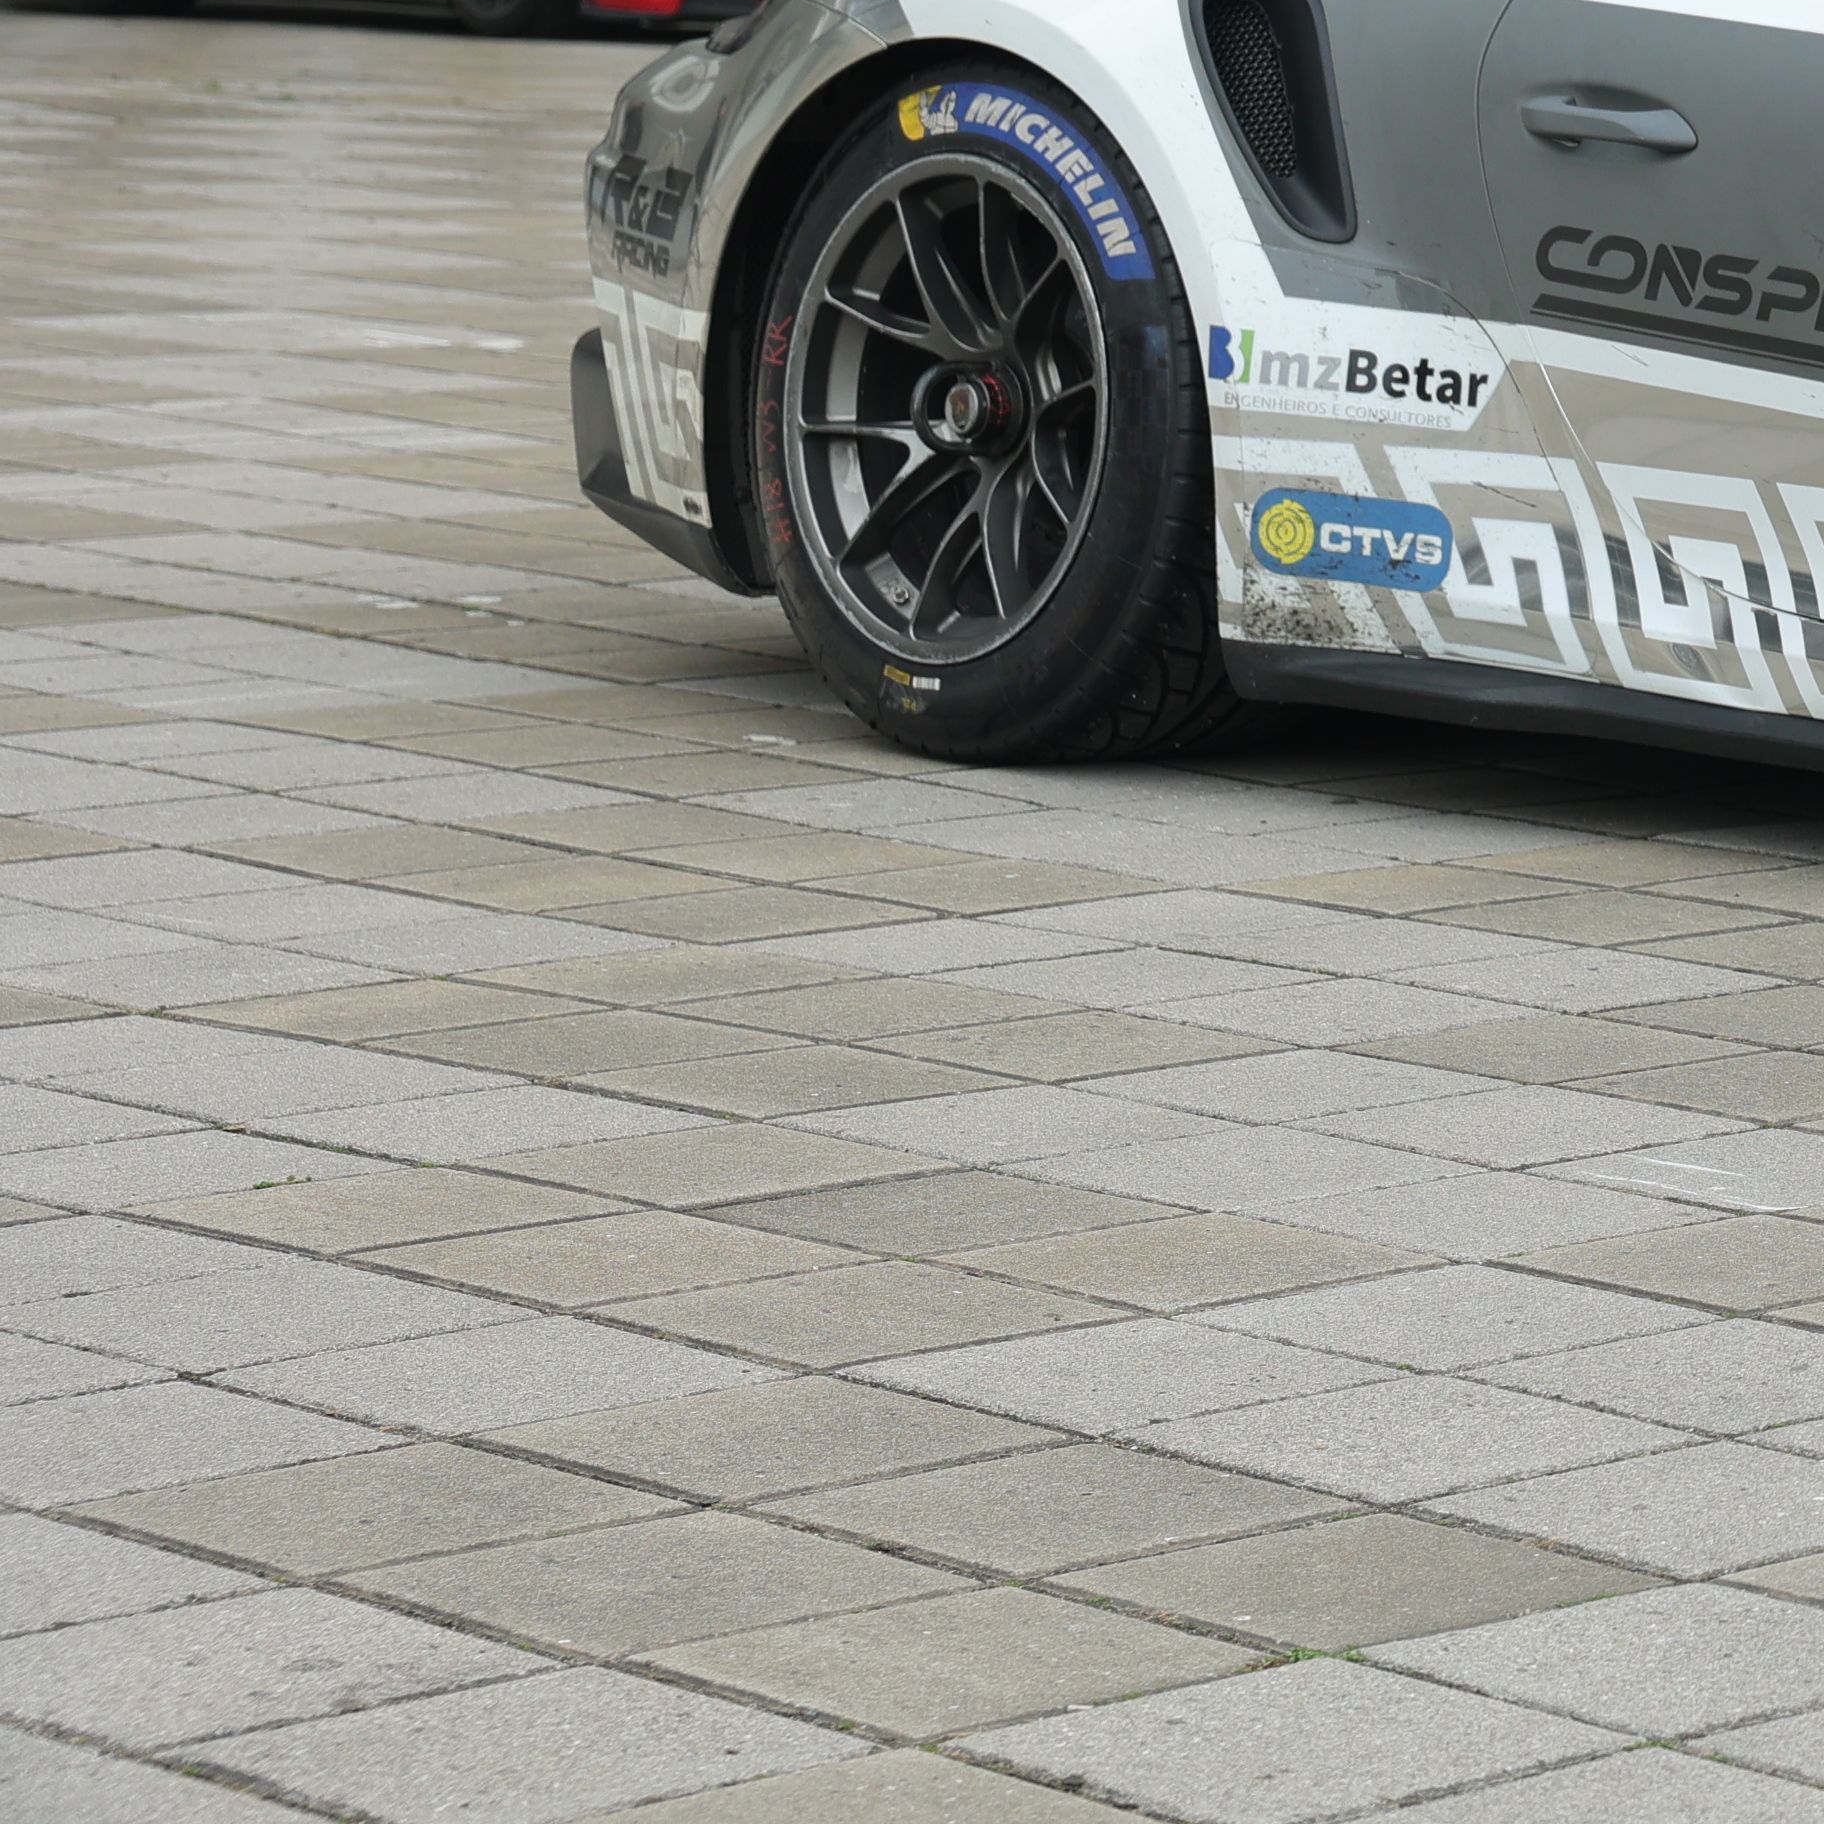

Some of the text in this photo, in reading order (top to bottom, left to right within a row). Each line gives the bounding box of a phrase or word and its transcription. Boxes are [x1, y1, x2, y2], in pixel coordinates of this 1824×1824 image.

[964, 92, 1137, 257] MICHELIN
[1224, 391, 1451, 428] ENGENHEIROS E CONSULTORES
[1320, 522, 1443, 565] CTVS
